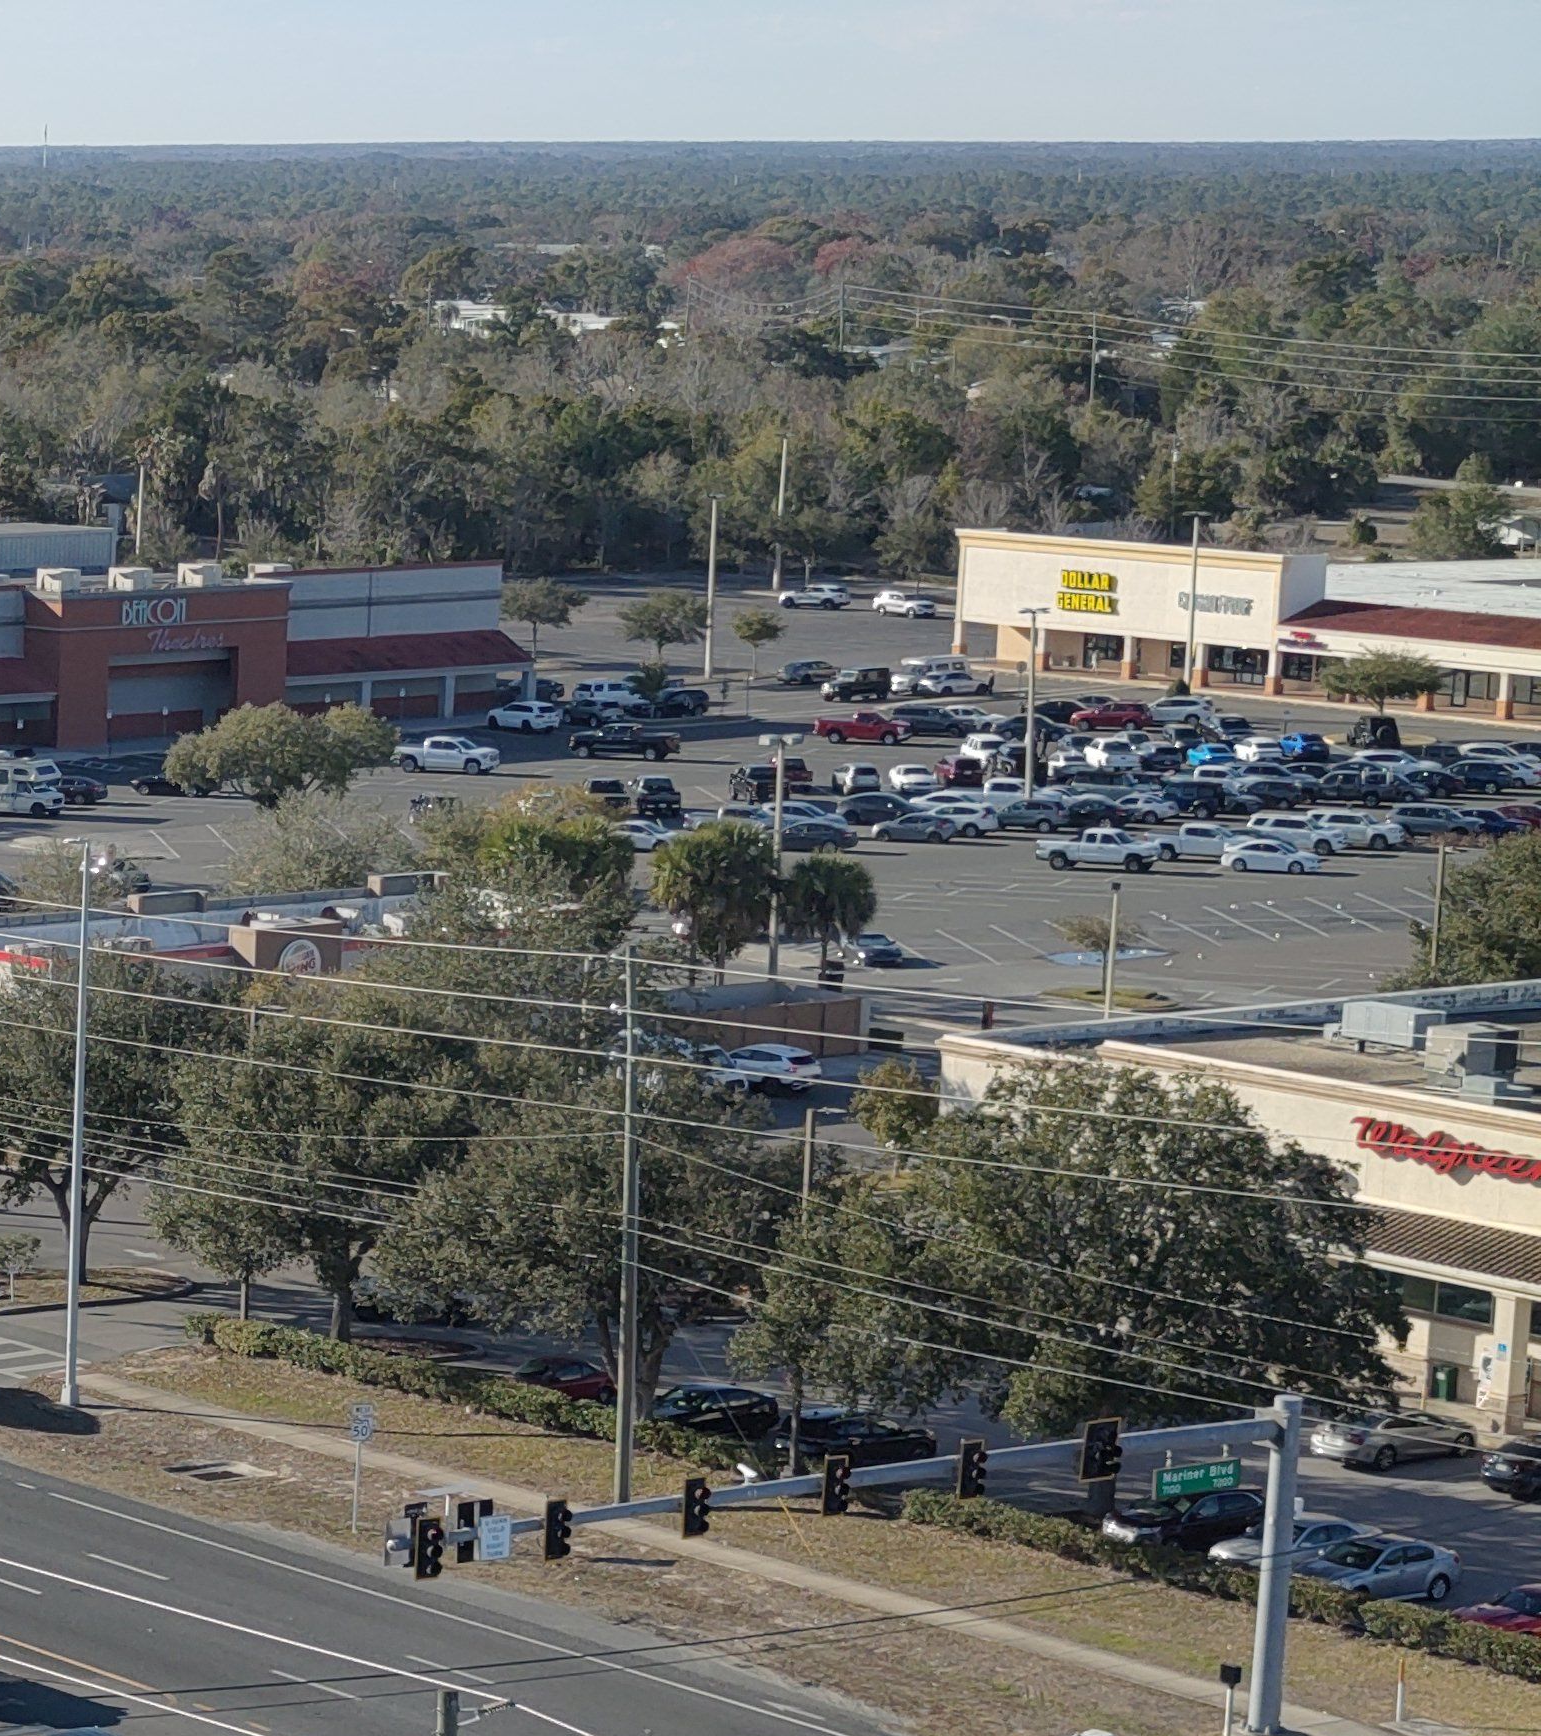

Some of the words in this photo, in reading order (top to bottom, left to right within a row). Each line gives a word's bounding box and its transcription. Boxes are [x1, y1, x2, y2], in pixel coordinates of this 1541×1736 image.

[1061, 570, 1112, 591] DOLLAR
[1056, 591, 1113, 613] GENERAL
[353, 1425, 368, 1437] 50
[1162, 1468, 1206, 1484] Mariner
[1209, 1463, 1234, 1477] Blvd
